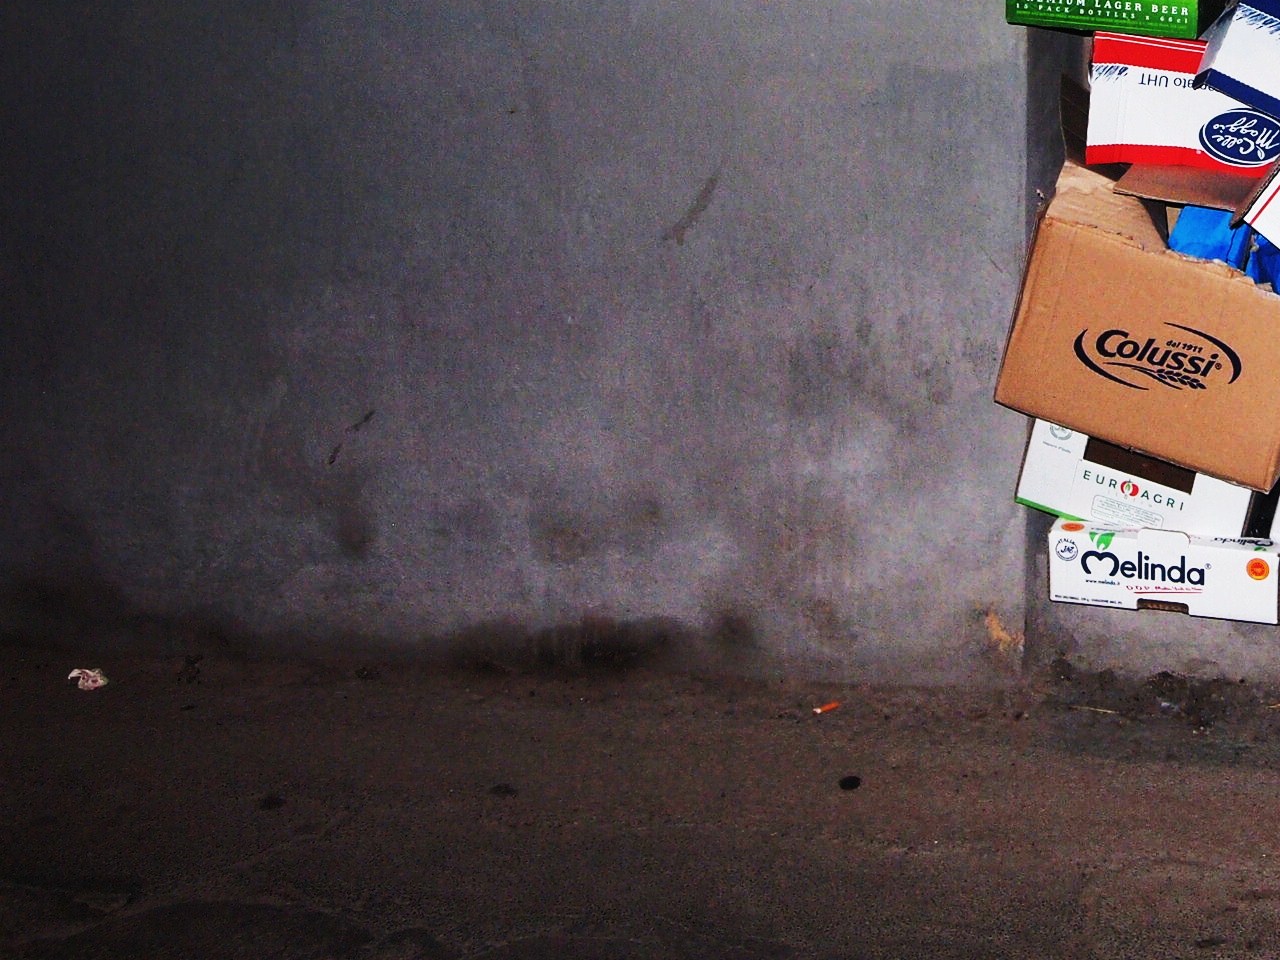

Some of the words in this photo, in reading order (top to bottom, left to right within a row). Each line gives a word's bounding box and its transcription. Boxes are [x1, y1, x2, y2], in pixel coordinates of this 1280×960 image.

[1038, 4, 1070, 13] PACK
[1080, 8, 1135, 19] BOTTLES
[1160, 15, 1188, 24] 66cl
[1095, 0, 1142, 12] LAGER
[1151, 4, 1189, 16] BEER
[1138, 73, 1168, 88] UHT
[1212, 132, 1256, 155] Colle
[1213, 116, 1280, 151] Maggio
[1095, 329, 1218, 378] Colussi
[1166, 340, 1181, 349] dal
[1182, 342, 1203, 353] 1911
[1214, 535, 1274, 547] Melinda
[1080, 550, 1205, 586] Melinda
